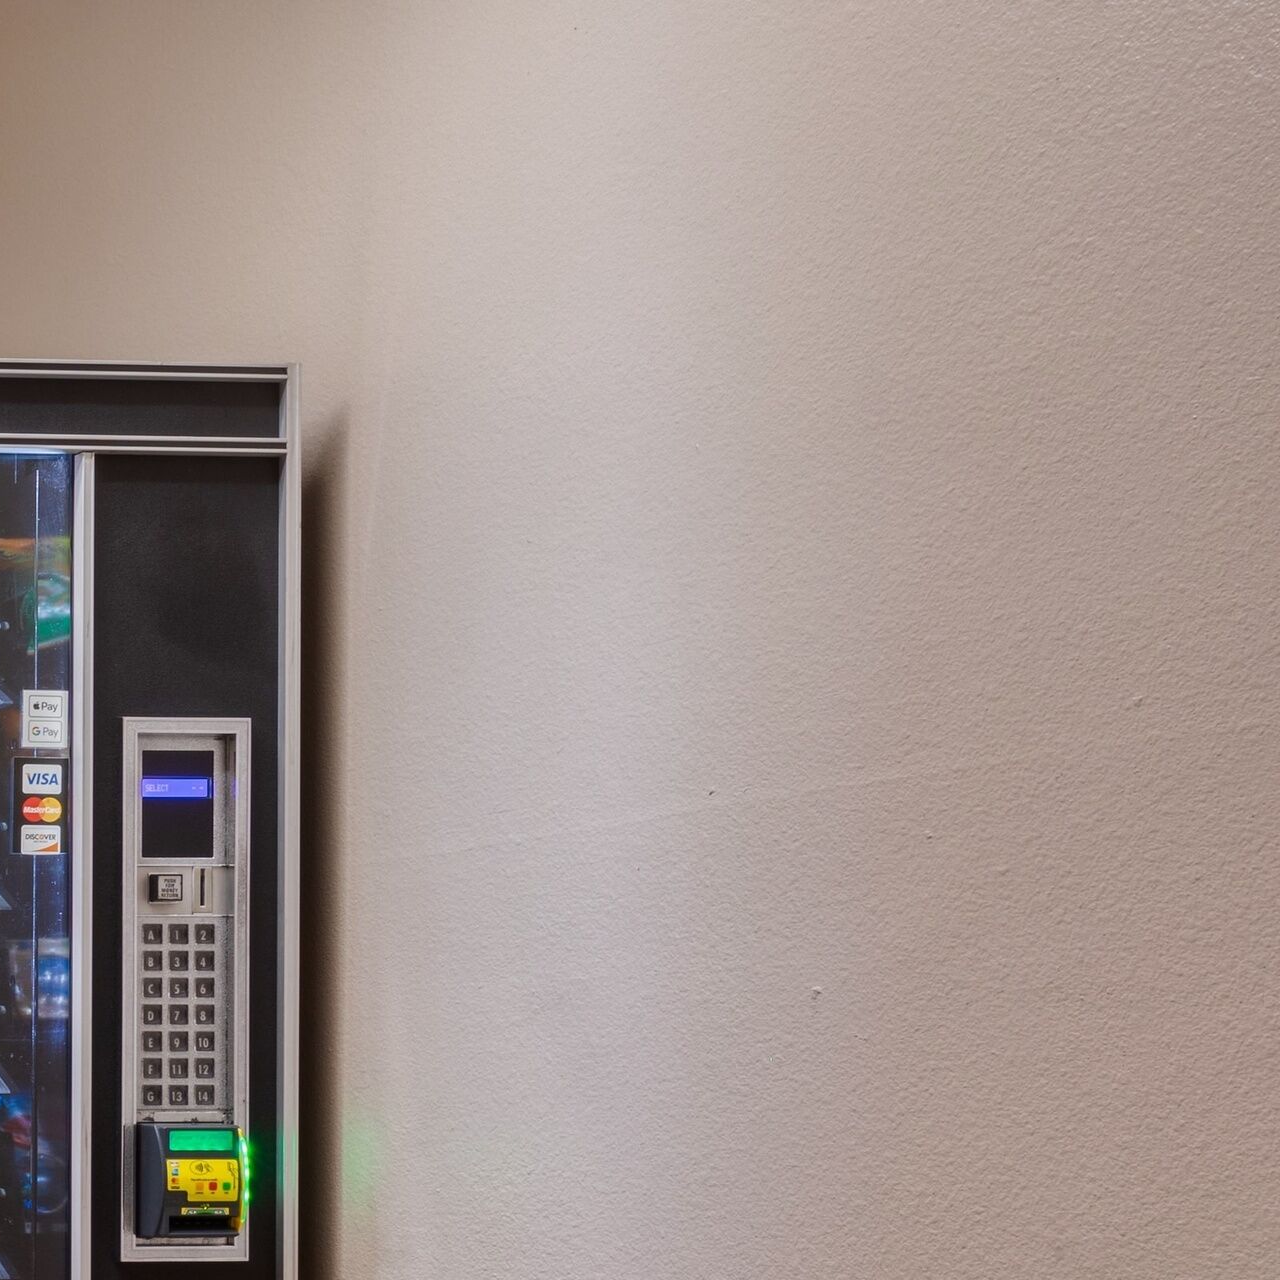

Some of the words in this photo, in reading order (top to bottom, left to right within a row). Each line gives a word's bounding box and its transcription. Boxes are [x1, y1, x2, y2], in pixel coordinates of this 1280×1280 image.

[41, 701, 59, 712] Pay
[42, 727, 59, 738] Pay
[26, 772, 59, 786] VISA
[144, 783, 169, 792] SELECT
[23, 806, 61, 815] MasterCard
[25, 833, 56, 841] DISCOVER
[147, 930, 154, 940] A
[200, 930, 206, 940] 2
[147, 957, 154, 967] B
[174, 957, 180, 967] 3
[200, 957, 206, 967] 4
[147, 984, 154, 994] C
[174, 984, 180, 994] 5
[200, 984, 206, 994] 6
[147, 1011, 154, 1021] D
[174, 1011, 180, 1021] 7
[200, 1011, 206, 1021] 8
[147, 1038, 154, 1048] E
[174, 1038, 180, 1048] 9
[198, 1038, 209, 1048] 10
[147, 1065, 154, 1075] F
[172, 1065, 182, 1075] 11
[198, 1065, 209, 1075] 12
[147, 1091, 154, 1101] G
[172, 1091, 182, 1101] 13
[198, 1091, 209, 1101] 14
